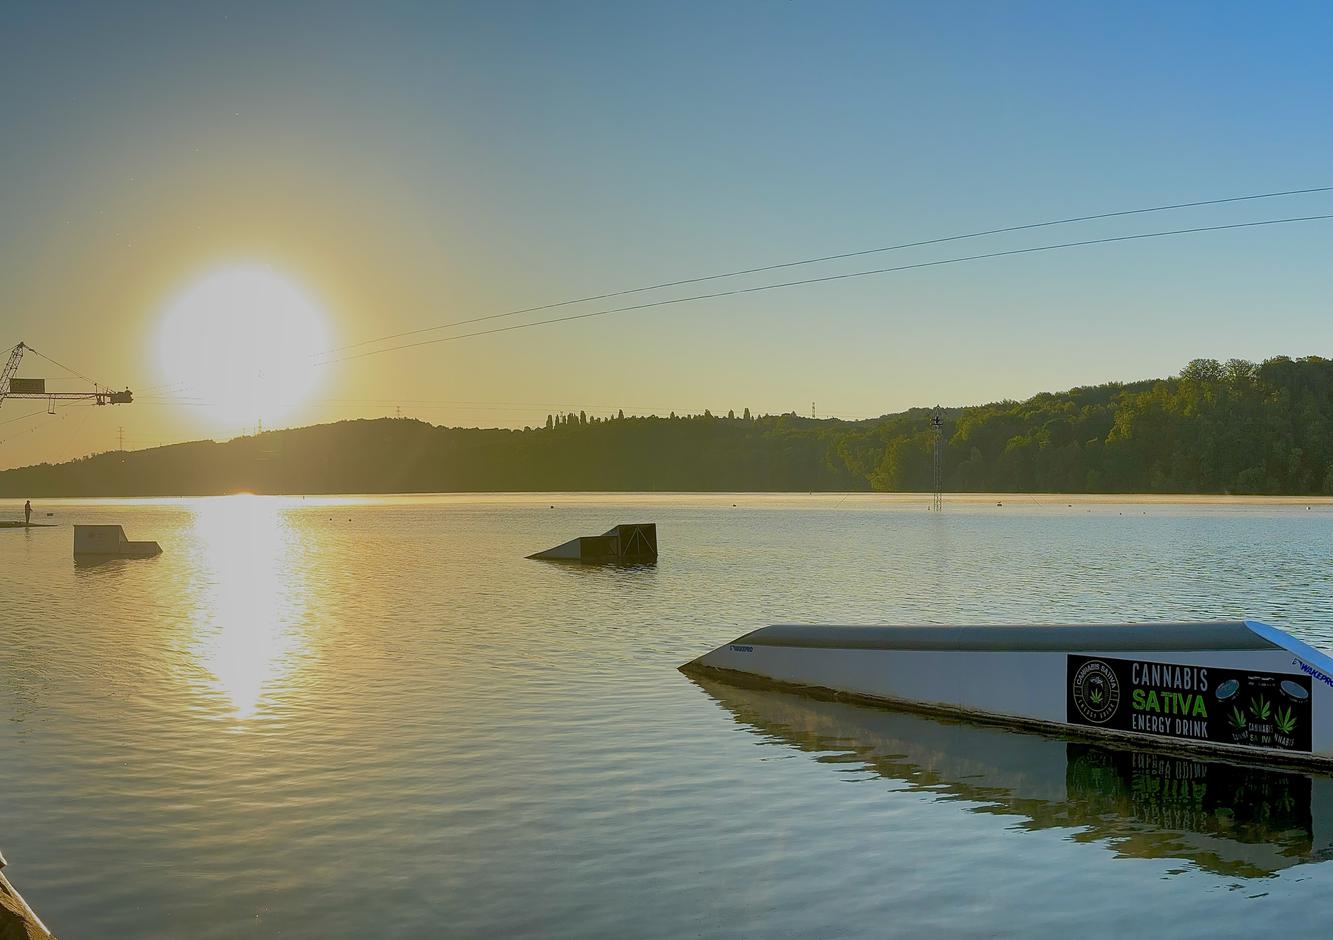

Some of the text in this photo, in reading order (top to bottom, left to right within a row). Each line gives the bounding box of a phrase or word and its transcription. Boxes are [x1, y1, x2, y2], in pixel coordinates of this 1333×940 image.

[1132, 662, 1208, 692] CANNABIS
[1132, 688, 1208, 718] SATIVA
[1132, 713, 1171, 734] ENERGY
[1175, 718, 1208, 738] DRINK
